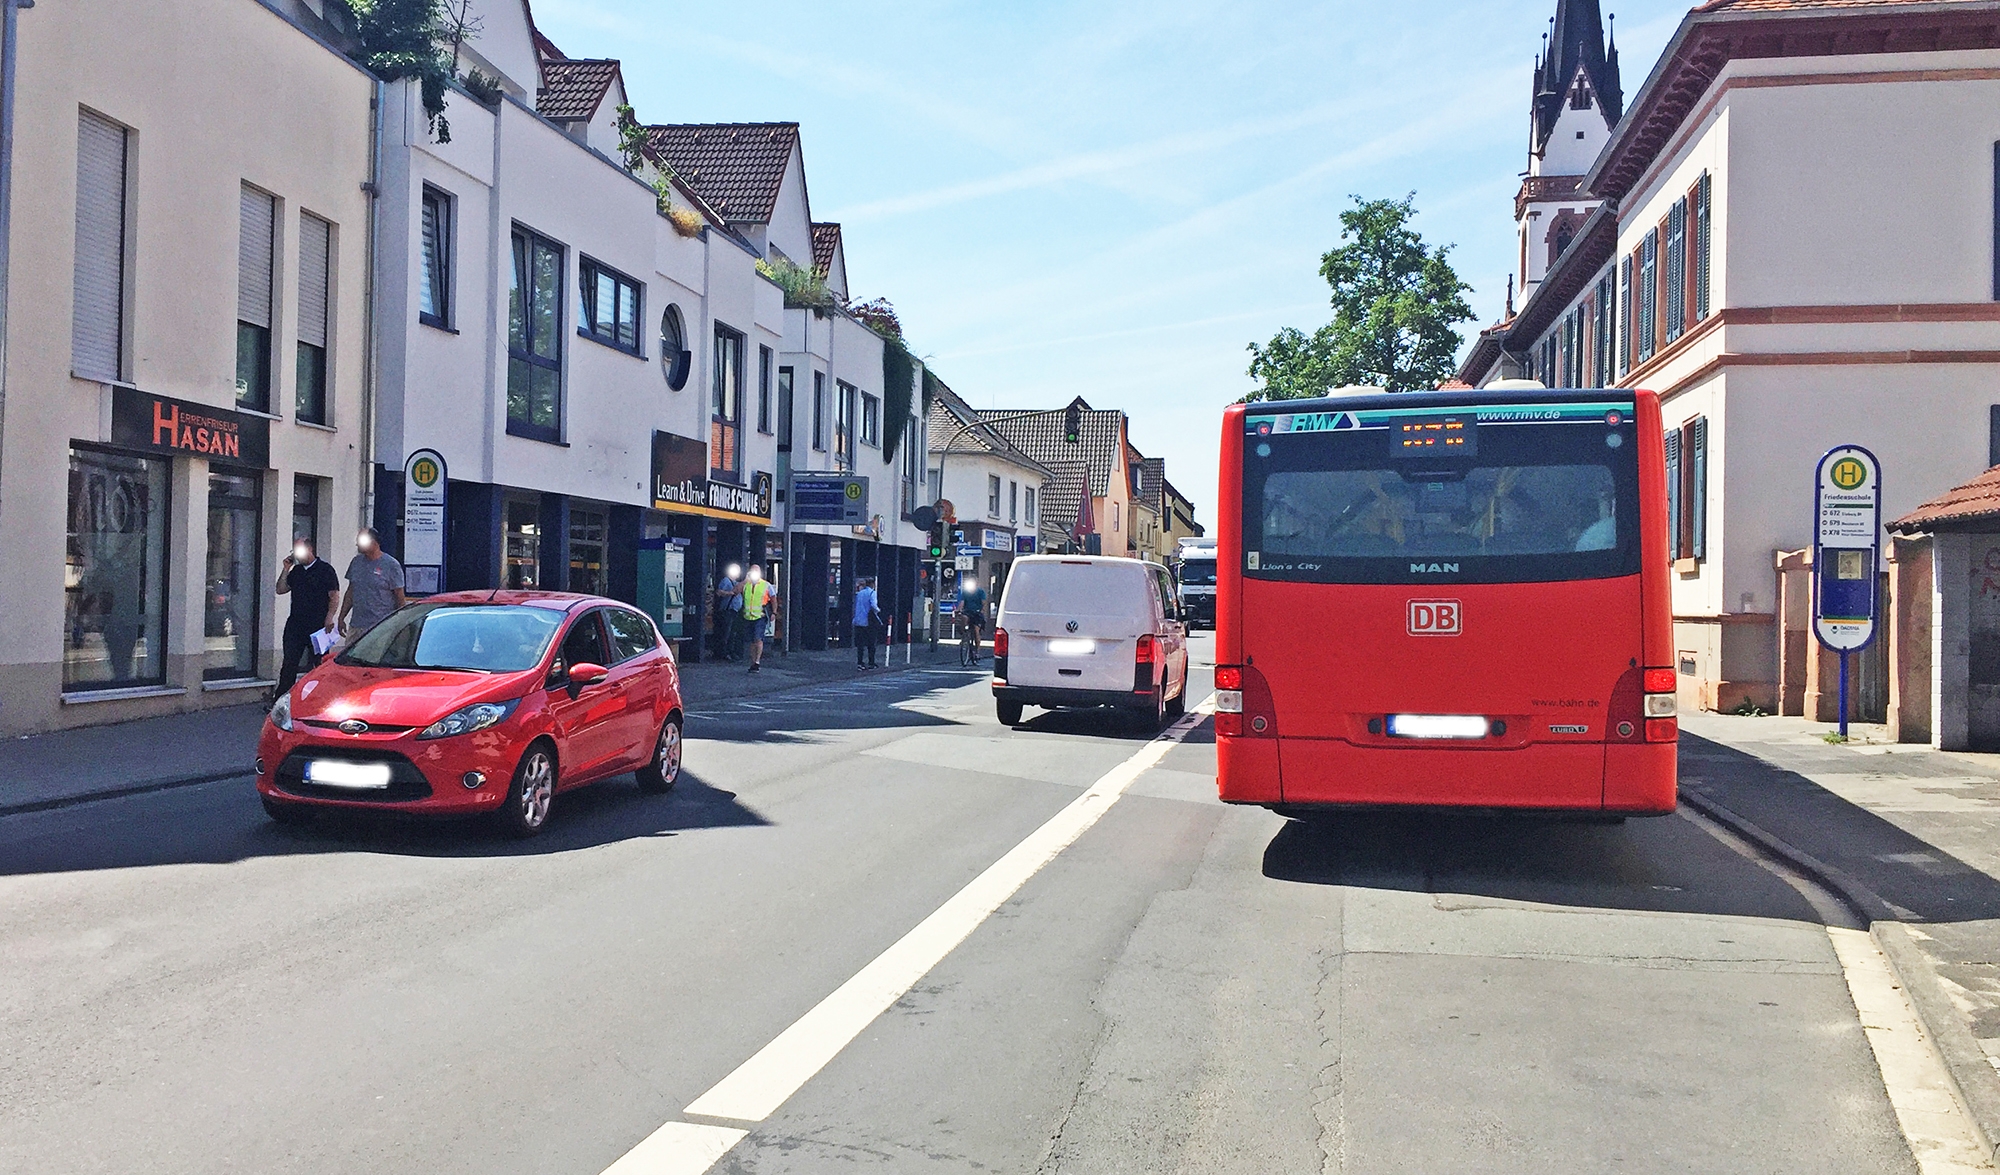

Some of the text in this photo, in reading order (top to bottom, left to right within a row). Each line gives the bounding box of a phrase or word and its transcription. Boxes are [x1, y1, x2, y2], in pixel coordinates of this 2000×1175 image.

[1476, 410, 1561, 421] www.rmv.de
[152, 401, 239, 458] HASAN
[657, 474, 705, 505] Learn & Drive
[709, 483, 759, 515] FAHRSCHULE
[1298, 563, 1322, 571] City
[1410, 563, 1459, 573] MAN
[1414, 605, 1455, 629] DB
